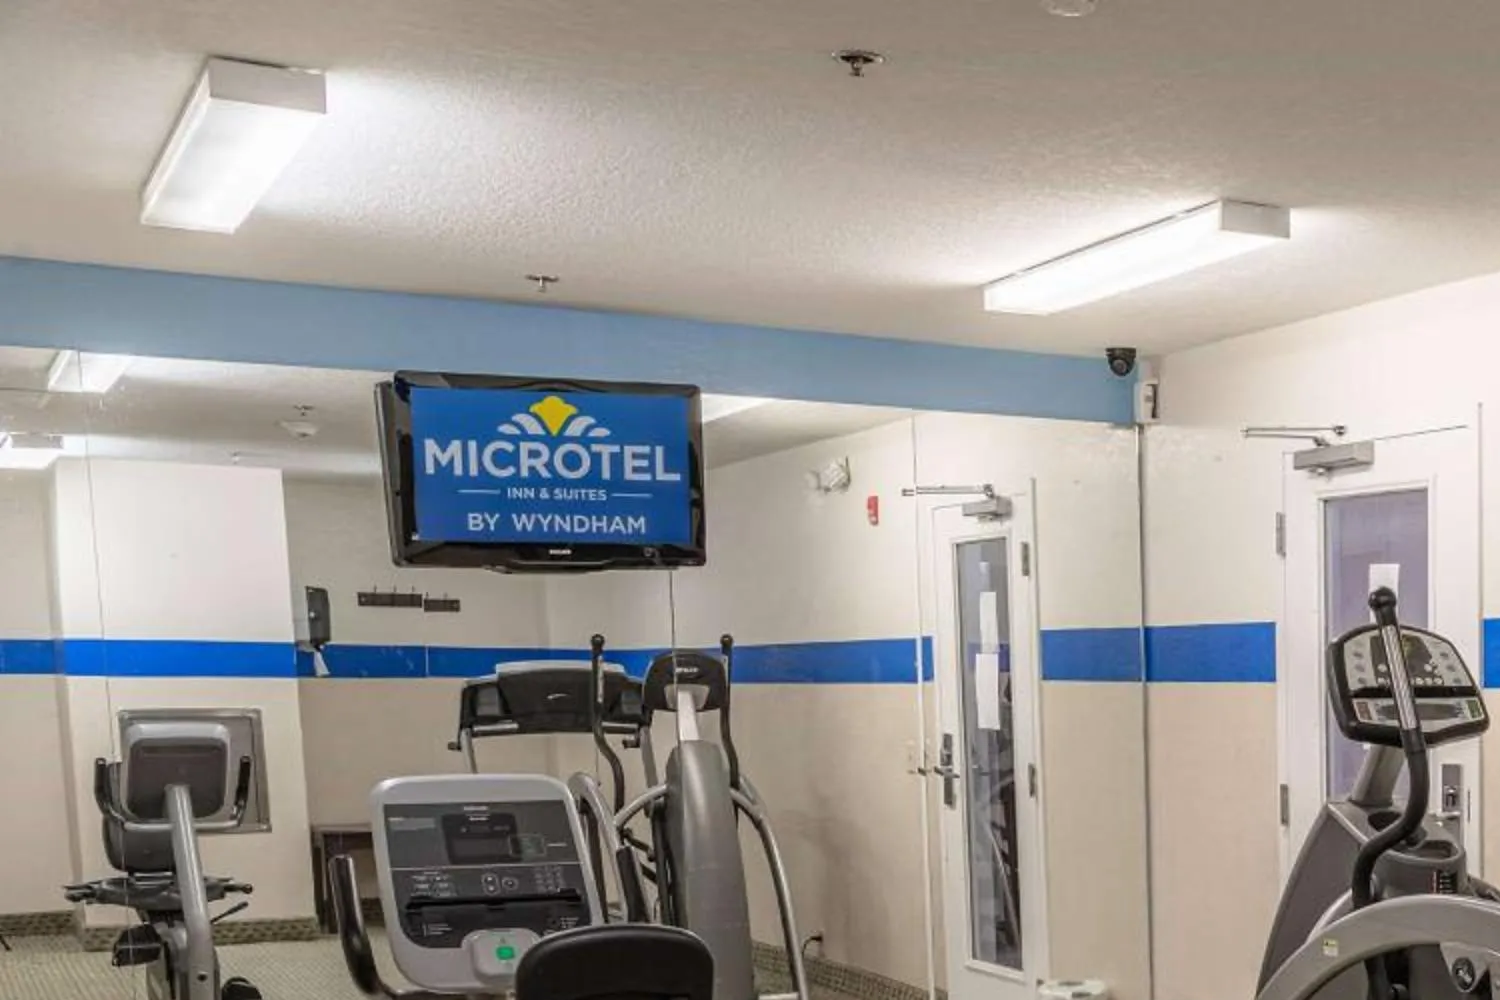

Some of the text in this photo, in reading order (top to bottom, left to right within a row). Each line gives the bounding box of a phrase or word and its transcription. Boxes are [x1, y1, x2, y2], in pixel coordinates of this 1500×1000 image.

[423, 438, 681, 482] MICROTEL
[507, 487, 608, 501] INN & SUITES
[467, 513, 647, 535] BY WYNDHAM
